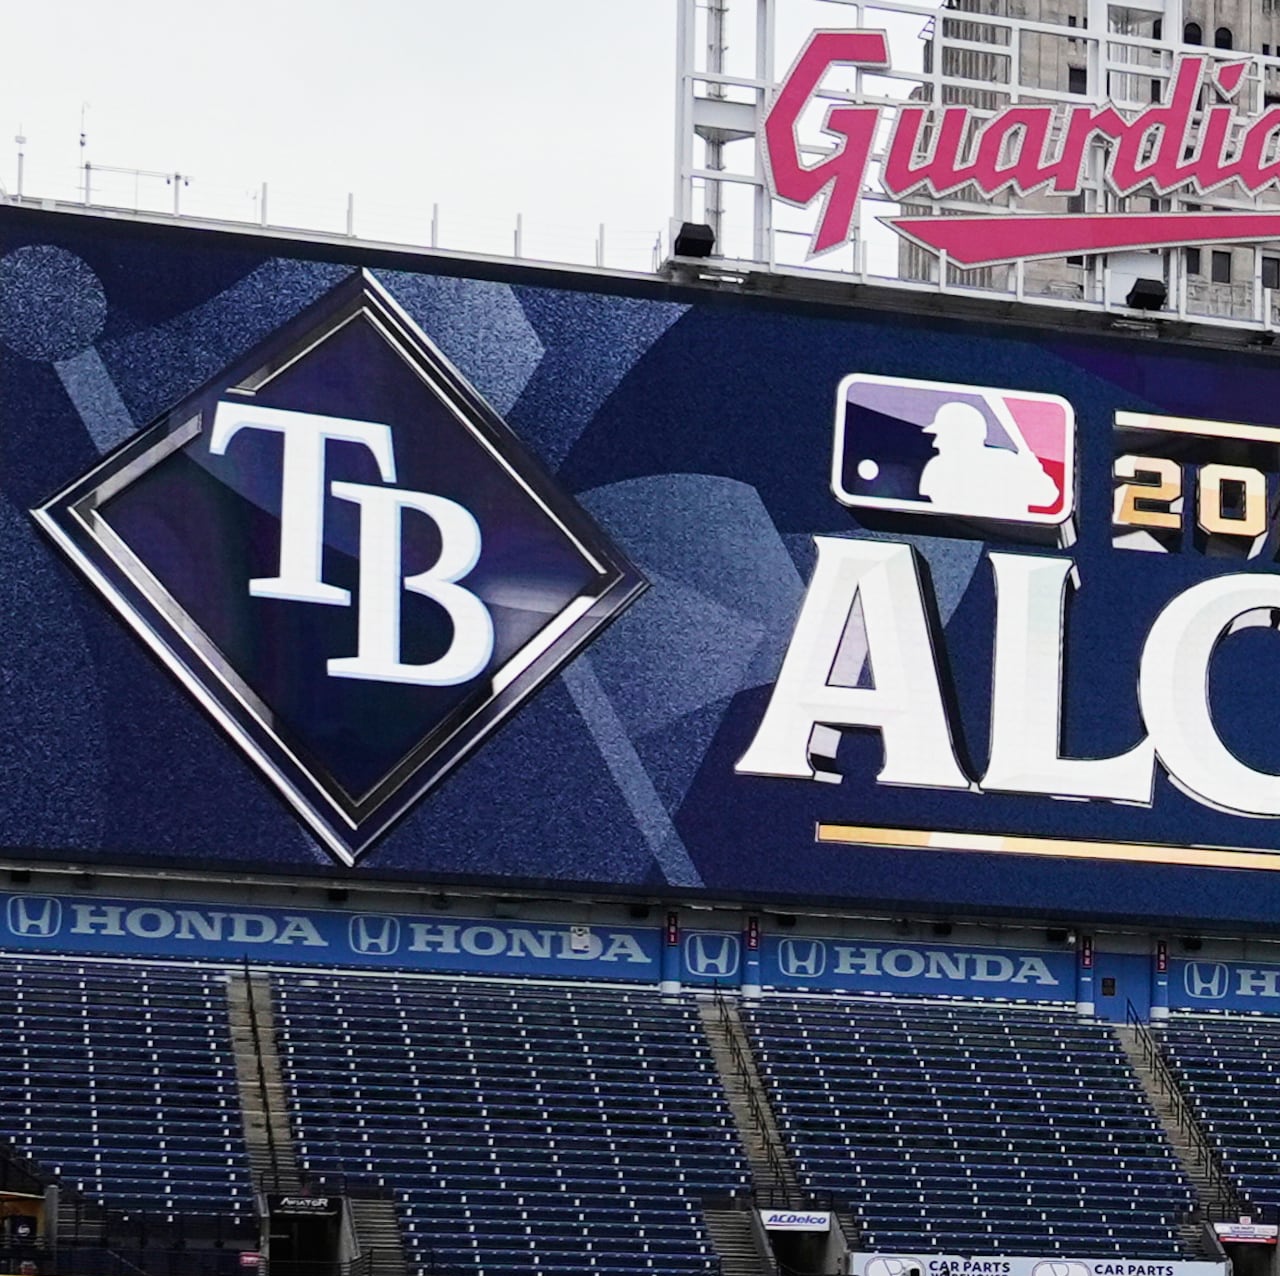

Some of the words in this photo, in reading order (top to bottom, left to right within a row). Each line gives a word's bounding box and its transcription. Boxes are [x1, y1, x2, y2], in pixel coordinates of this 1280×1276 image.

[208, 400, 495, 687] TB
[69, 903, 330, 947] HONDA
[407, 923, 653, 964] HONDA
[833, 946, 1060, 986] HONDA
[767, 1213, 827, 1225] ACDelco
[929, 1260, 960, 1272] CAR
[963, 1261, 1010, 1273] PARTS
[1094, 1264, 1125, 1275] CAR
[1127, 1264, 1174, 1276] PARTS
